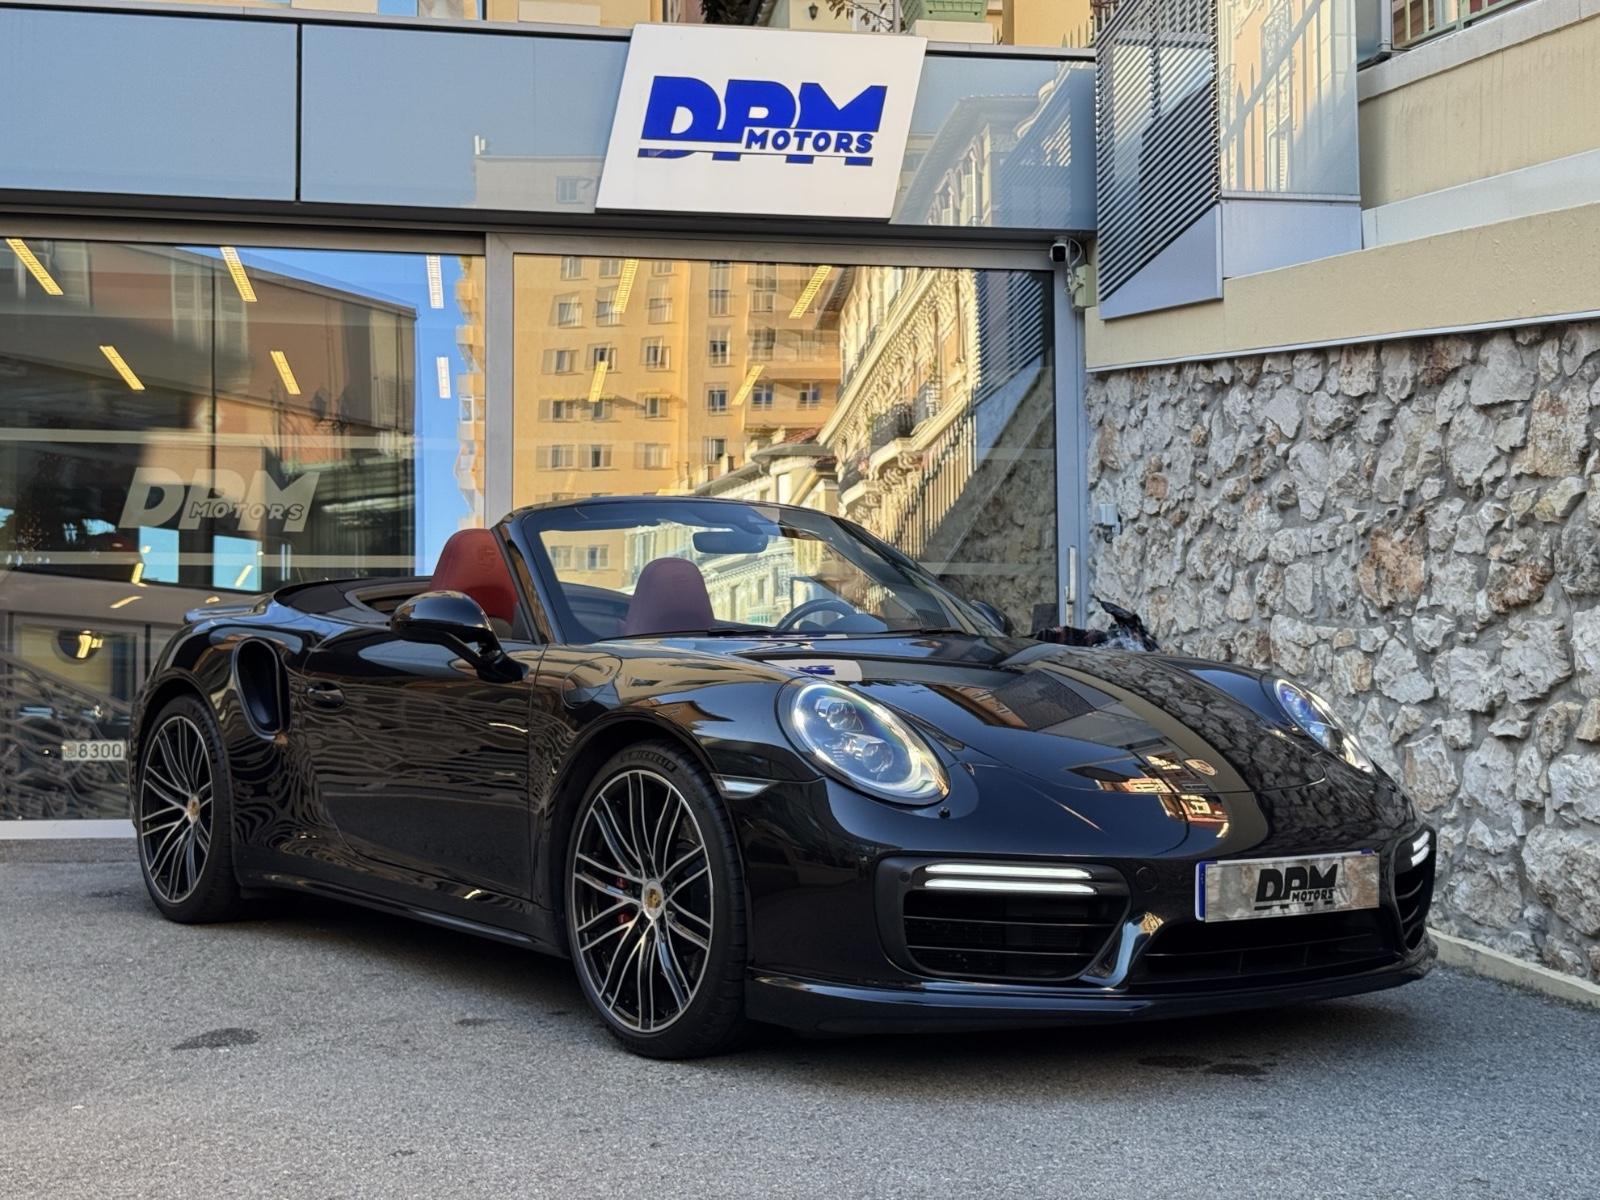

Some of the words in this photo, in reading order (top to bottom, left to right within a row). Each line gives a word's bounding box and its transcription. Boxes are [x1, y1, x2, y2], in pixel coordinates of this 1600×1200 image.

[637, 75, 888, 166] DPM
[745, 129, 874, 154] MOTORS
[118, 467, 321, 532] DPM
[189, 502, 305, 521] MOTORS
[1254, 864, 1338, 911] DPM
[1292, 888, 1334, 902] MOTORS
